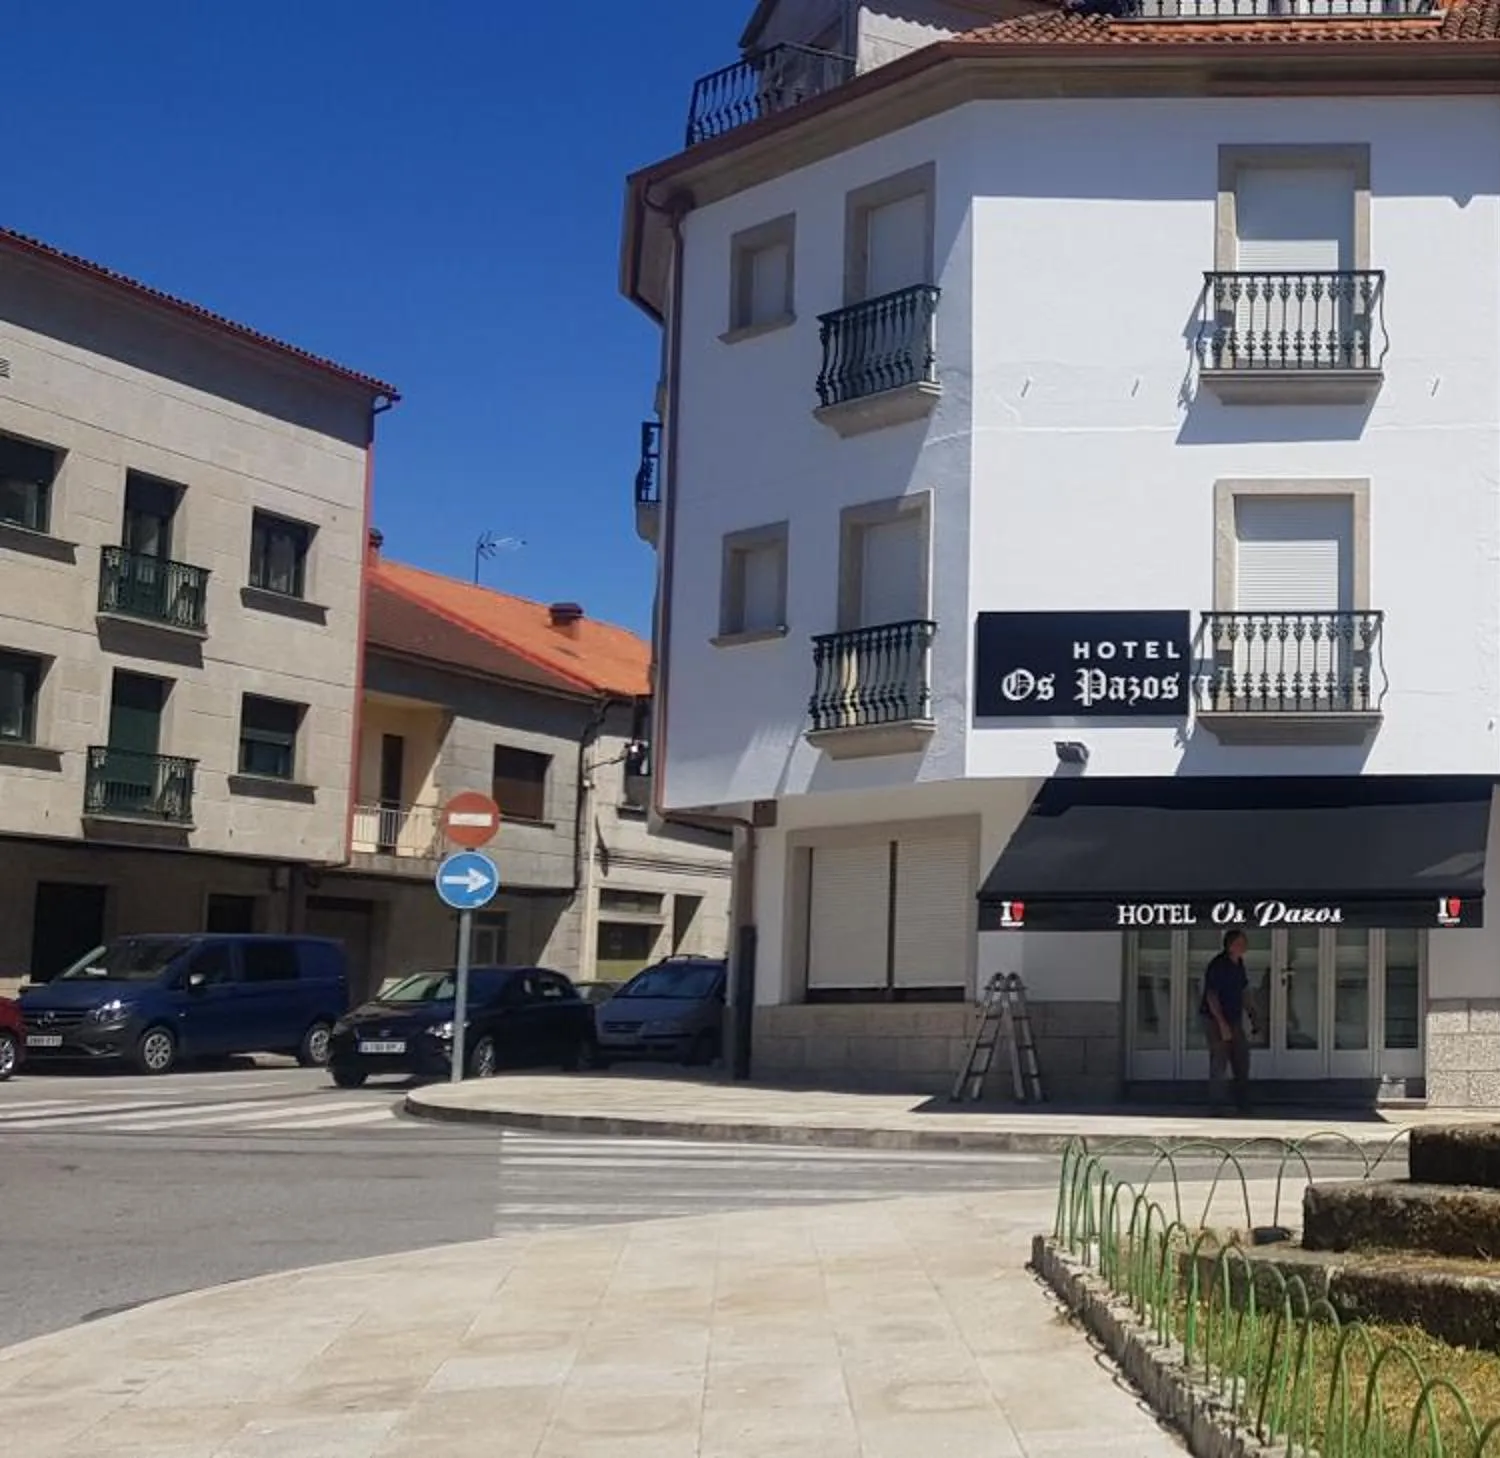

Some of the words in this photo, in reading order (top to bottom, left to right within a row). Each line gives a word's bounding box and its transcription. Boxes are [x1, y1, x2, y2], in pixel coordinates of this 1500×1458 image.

[1072, 640, 1181, 660] HOTEL
[1001, 667, 1056, 702] Os
[1072, 667, 1181, 707] Pazos
[1117, 903, 1197, 925] HOTEL
[1211, 900, 1247, 924] Os
[1253, 900, 1345, 927] Pazos
